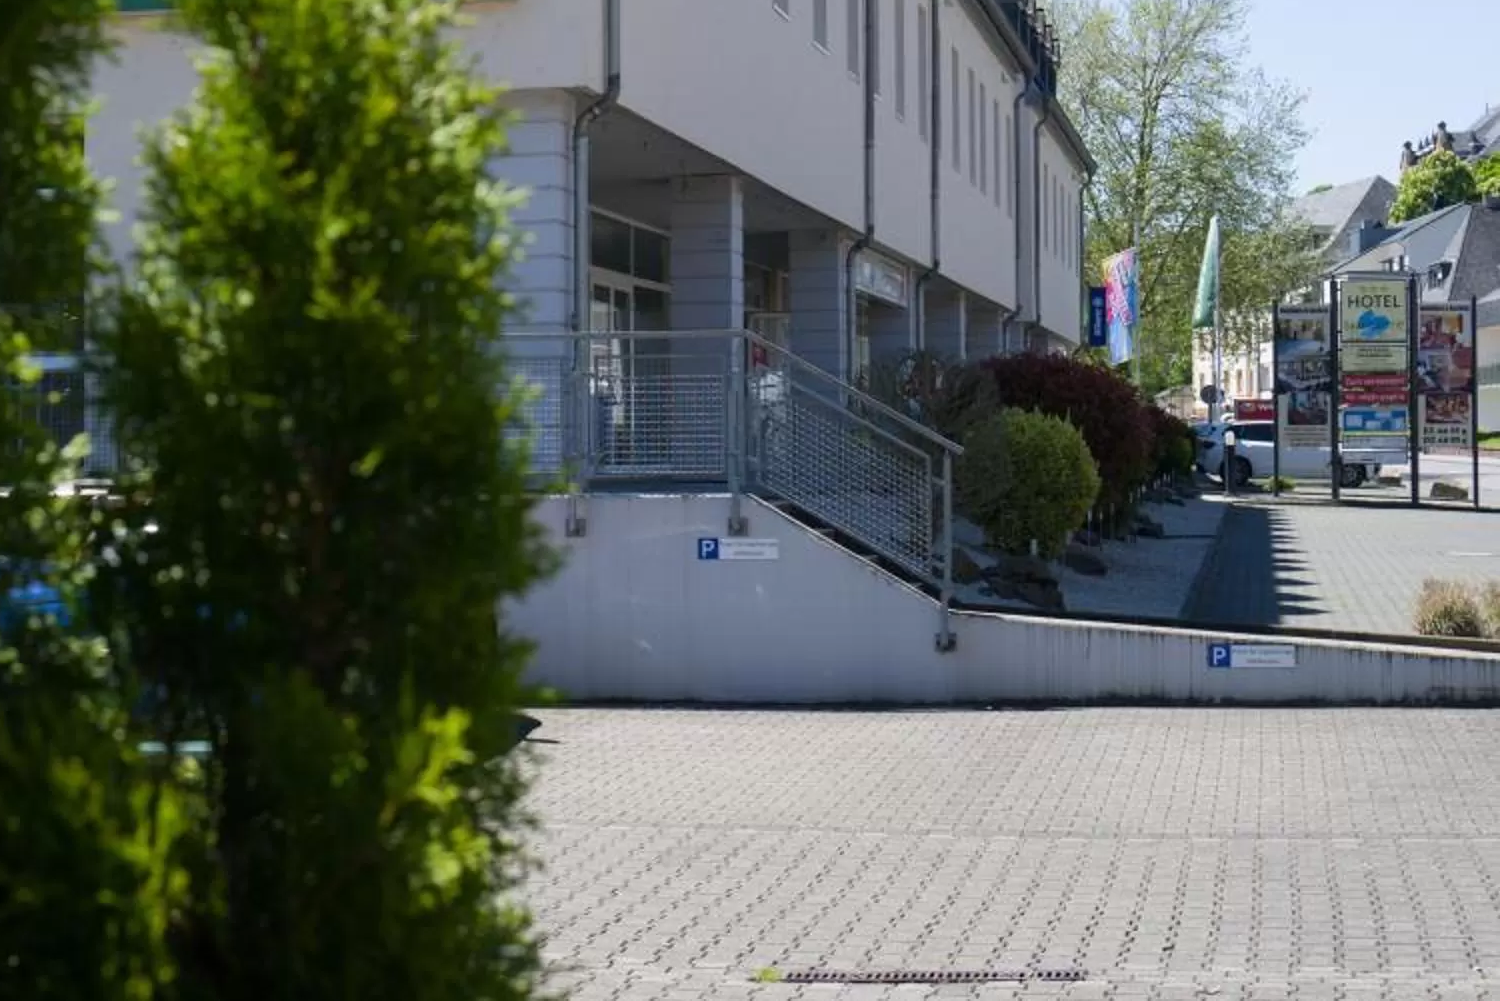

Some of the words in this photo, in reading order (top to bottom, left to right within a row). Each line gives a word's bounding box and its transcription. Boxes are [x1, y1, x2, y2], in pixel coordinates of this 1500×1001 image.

[1347, 294, 1405, 308] HOTEL
[701, 540, 716, 559] P
[1212, 646, 1227, 666] P
